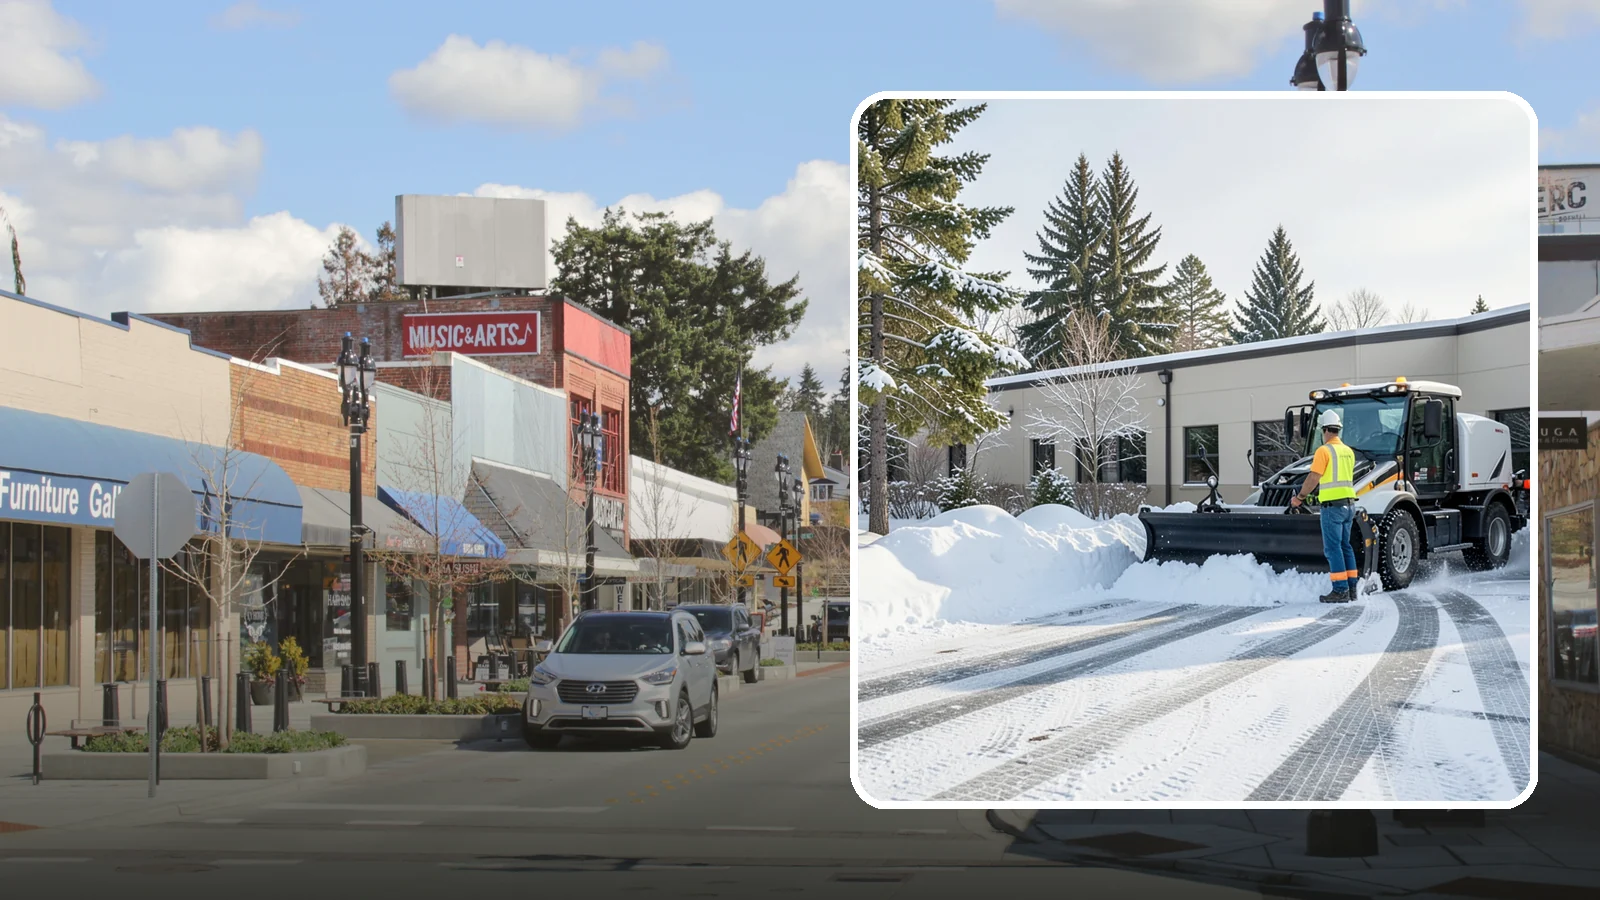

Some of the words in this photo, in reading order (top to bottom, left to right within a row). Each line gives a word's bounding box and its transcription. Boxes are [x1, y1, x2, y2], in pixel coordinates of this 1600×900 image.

[0, 471, 79, 515] Furniture
[89, 482, 122, 519] Gal
[453, 563, 479, 574] SUSHI
